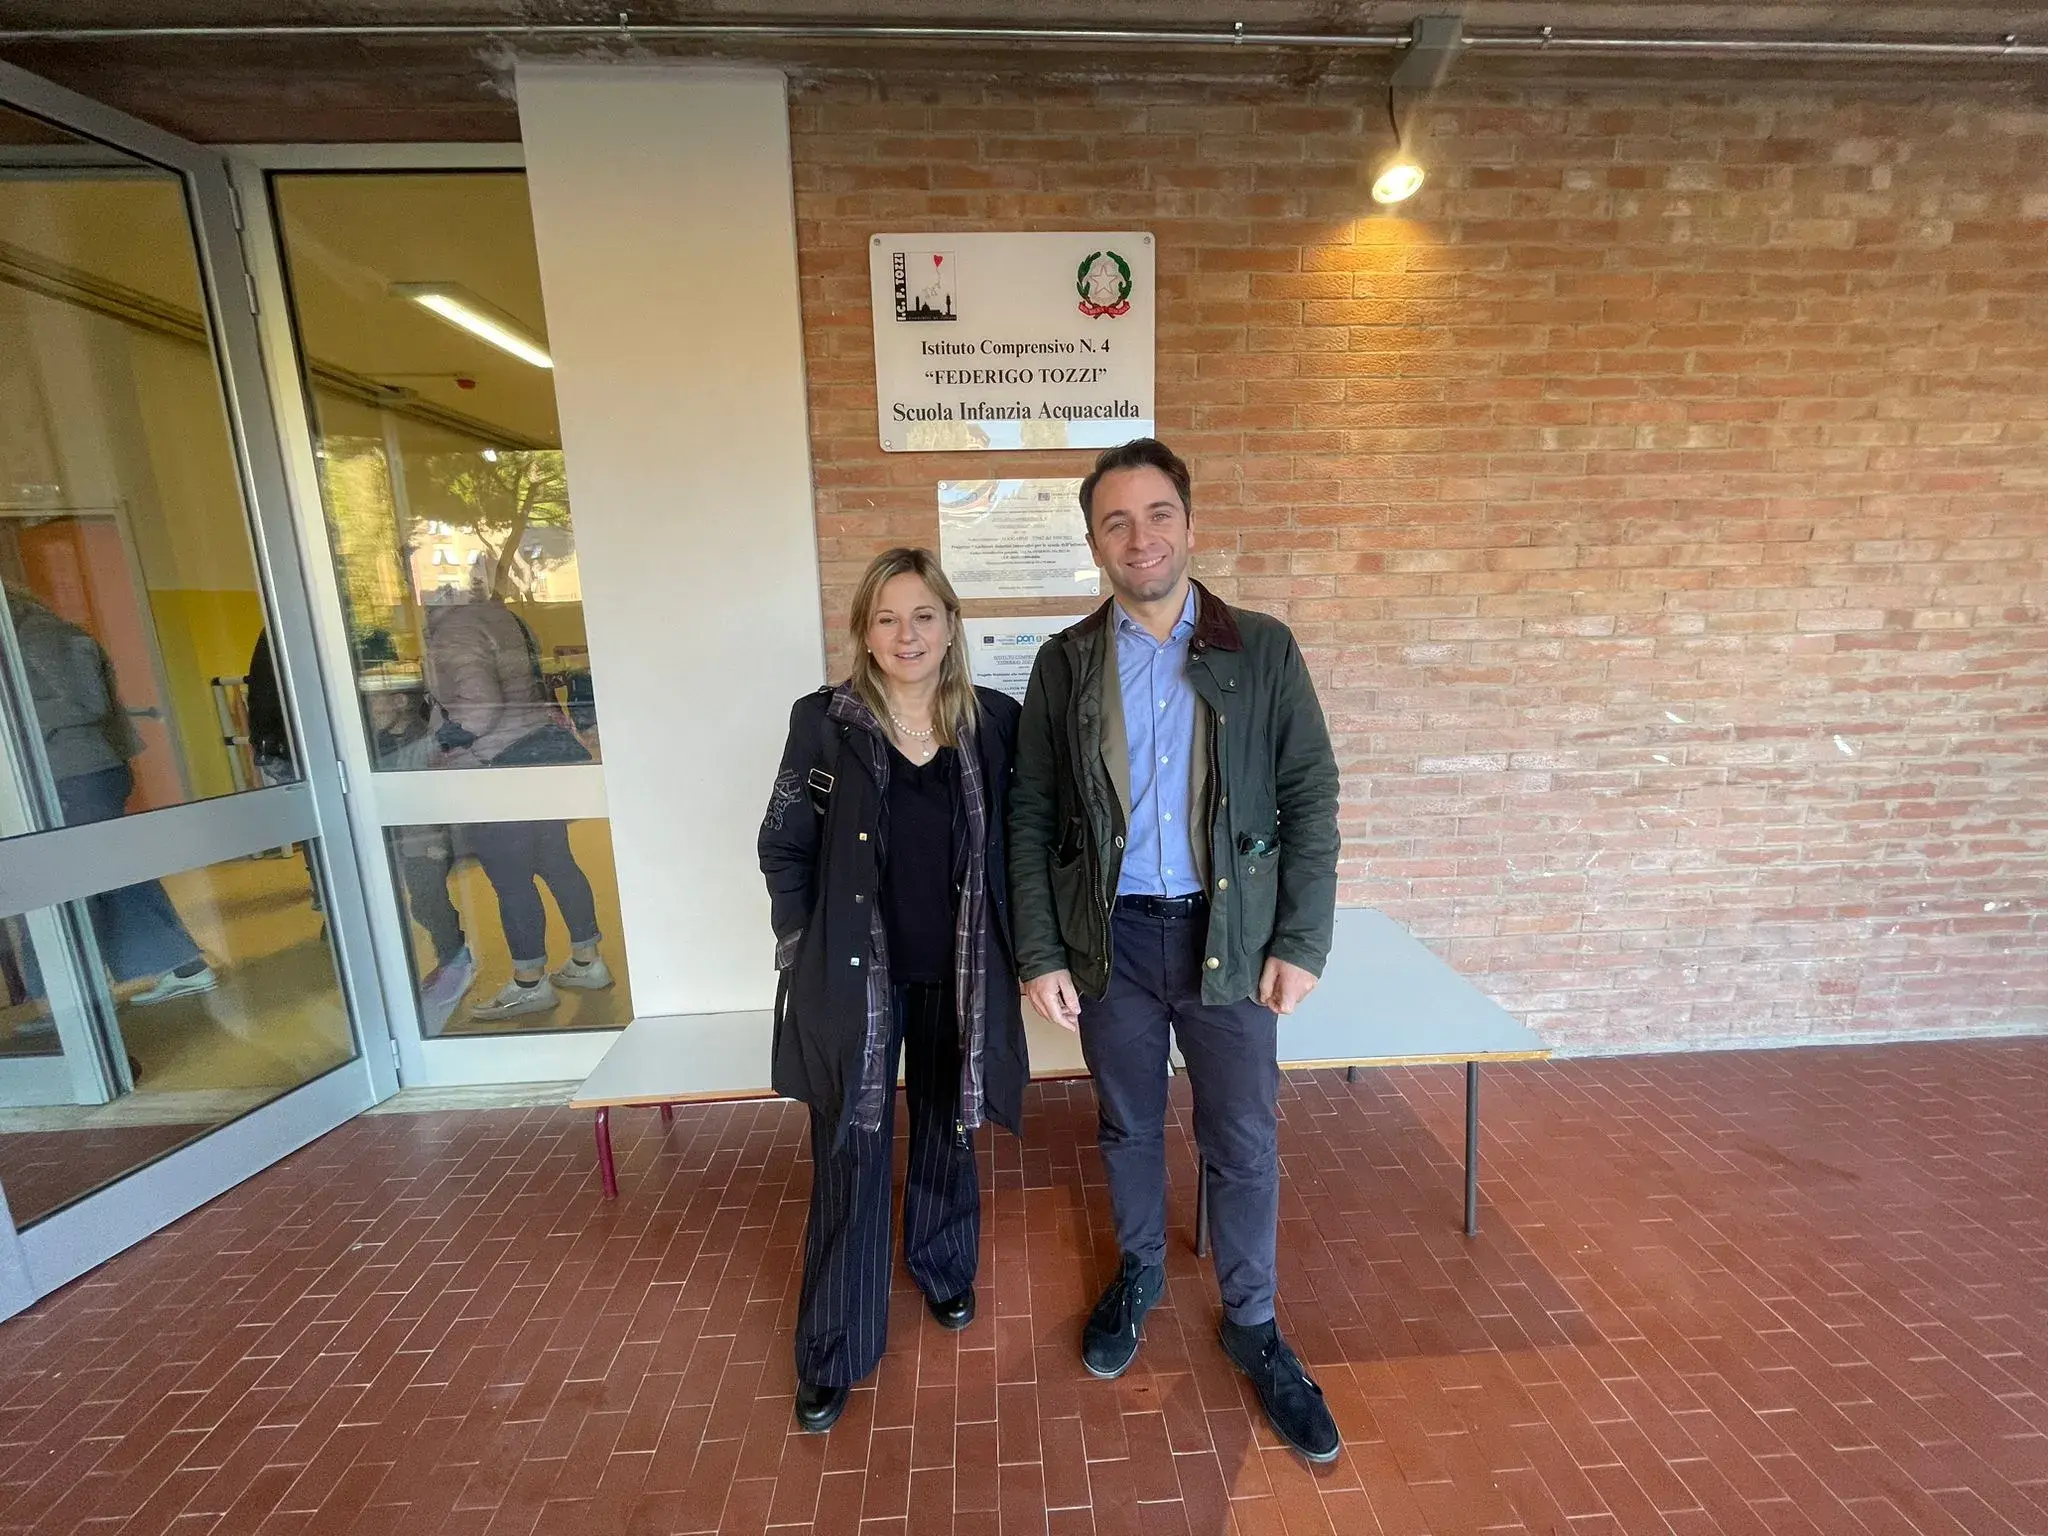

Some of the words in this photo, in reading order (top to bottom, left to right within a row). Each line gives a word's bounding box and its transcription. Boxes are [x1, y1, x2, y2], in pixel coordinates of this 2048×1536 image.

[893, 253, 905, 286] TOZZI
[896, 301, 907, 321] I.C.
[921, 340, 975, 355] Istituto
[980, 339, 1075, 358] Comprensivo
[1079, 338, 1096, 353] N.
[1100, 338, 1110, 353] 4
[892, 402, 953, 422] Scuola
[959, 401, 1032, 420] Infanzia
[1038, 399, 1140, 421] Acquacalda
